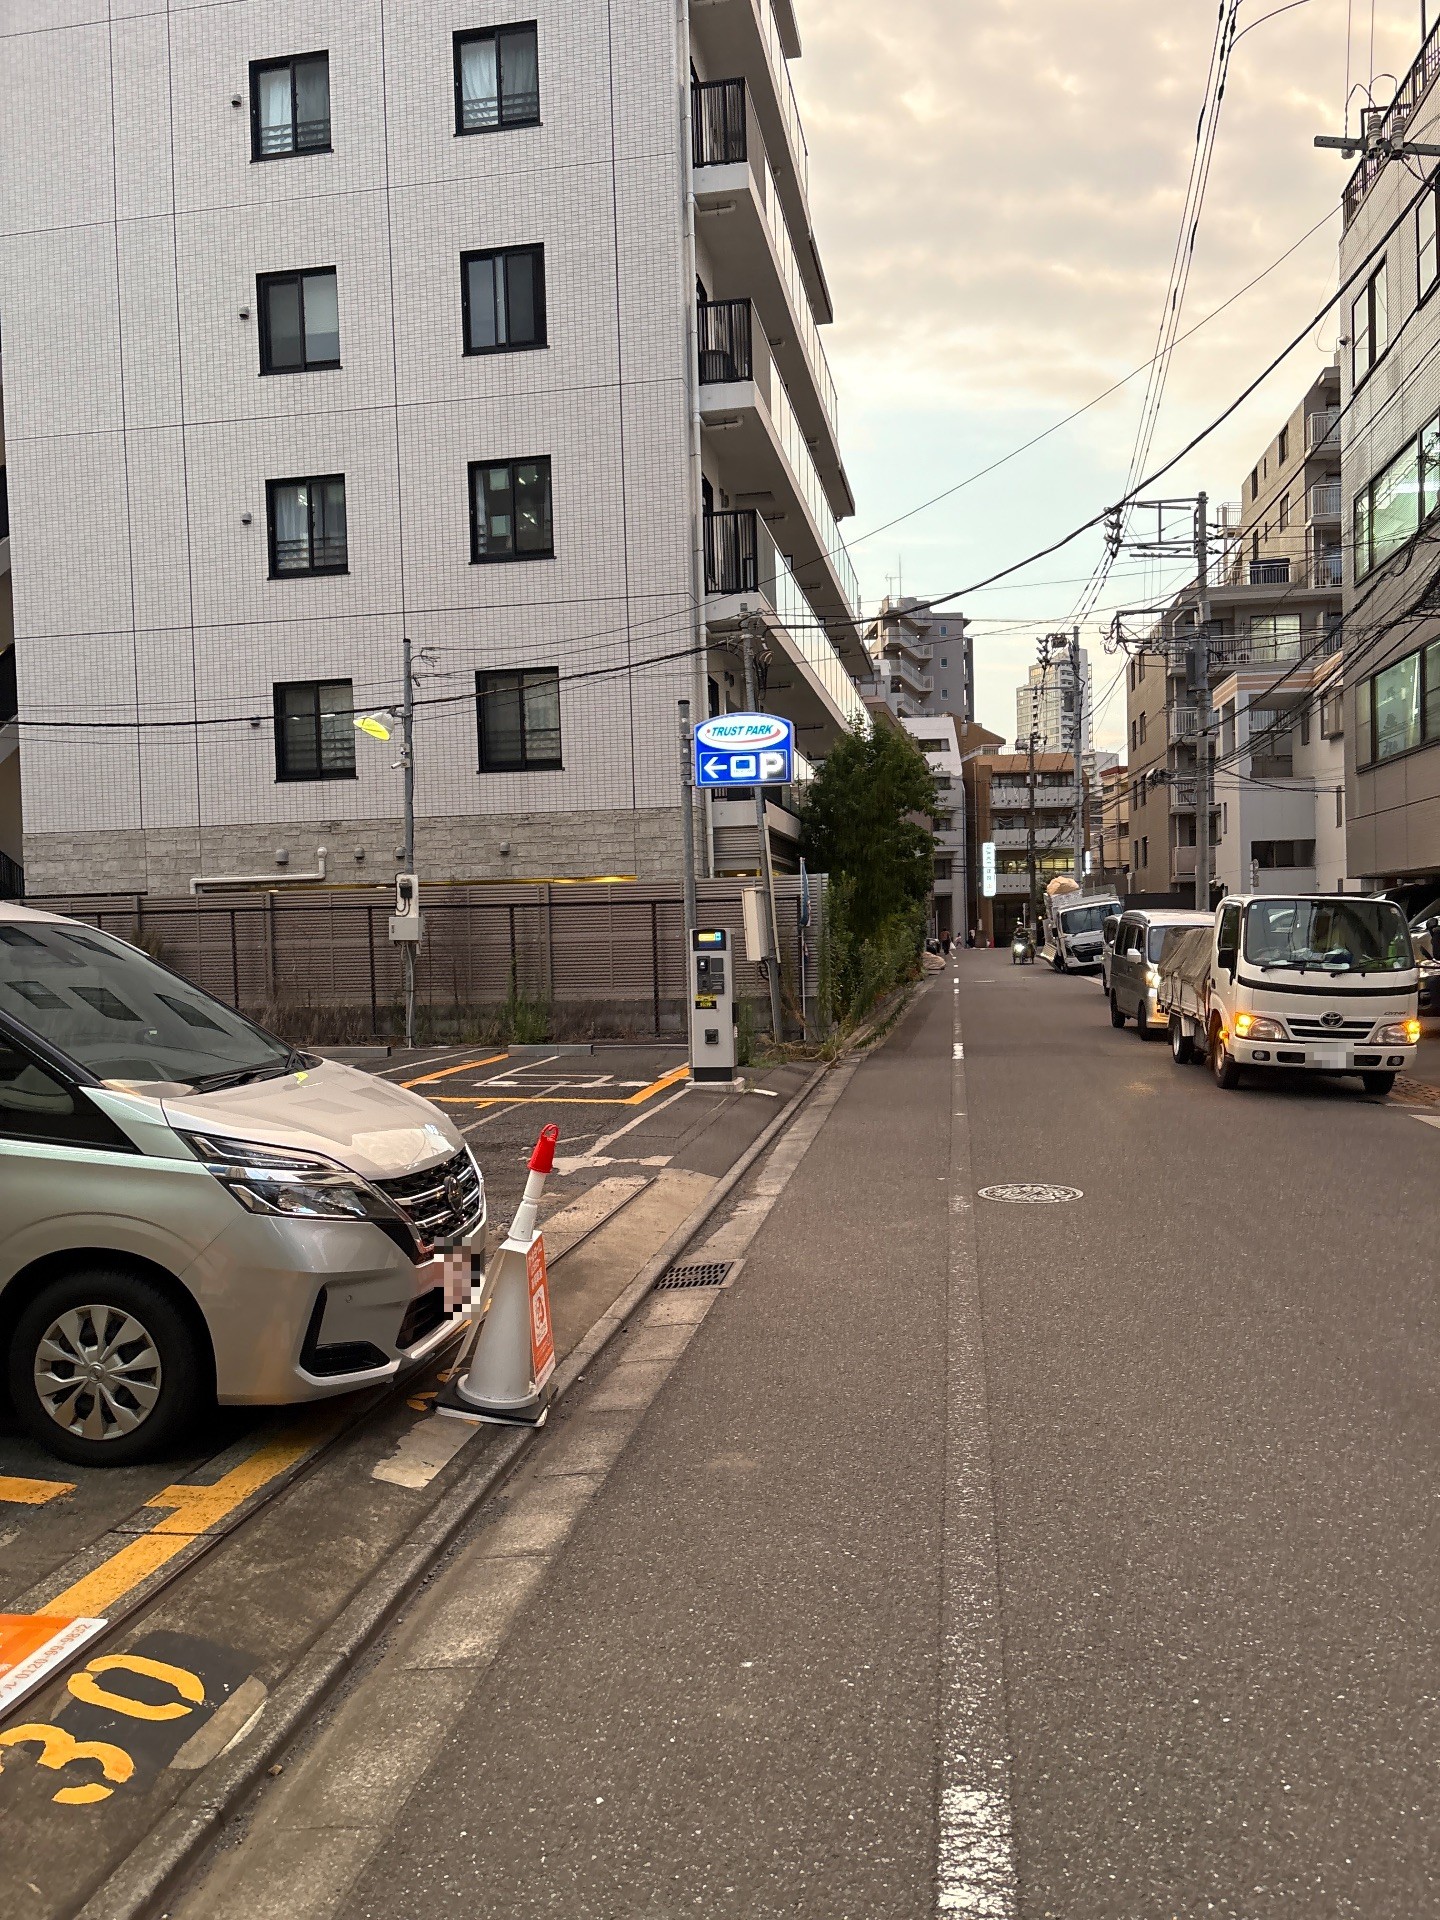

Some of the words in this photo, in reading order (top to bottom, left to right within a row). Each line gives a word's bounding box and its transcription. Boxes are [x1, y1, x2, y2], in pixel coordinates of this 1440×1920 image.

[711, 726, 745, 737] TRUST
[745, 724, 774, 736] PARK
[759, 752, 784, 780] P
